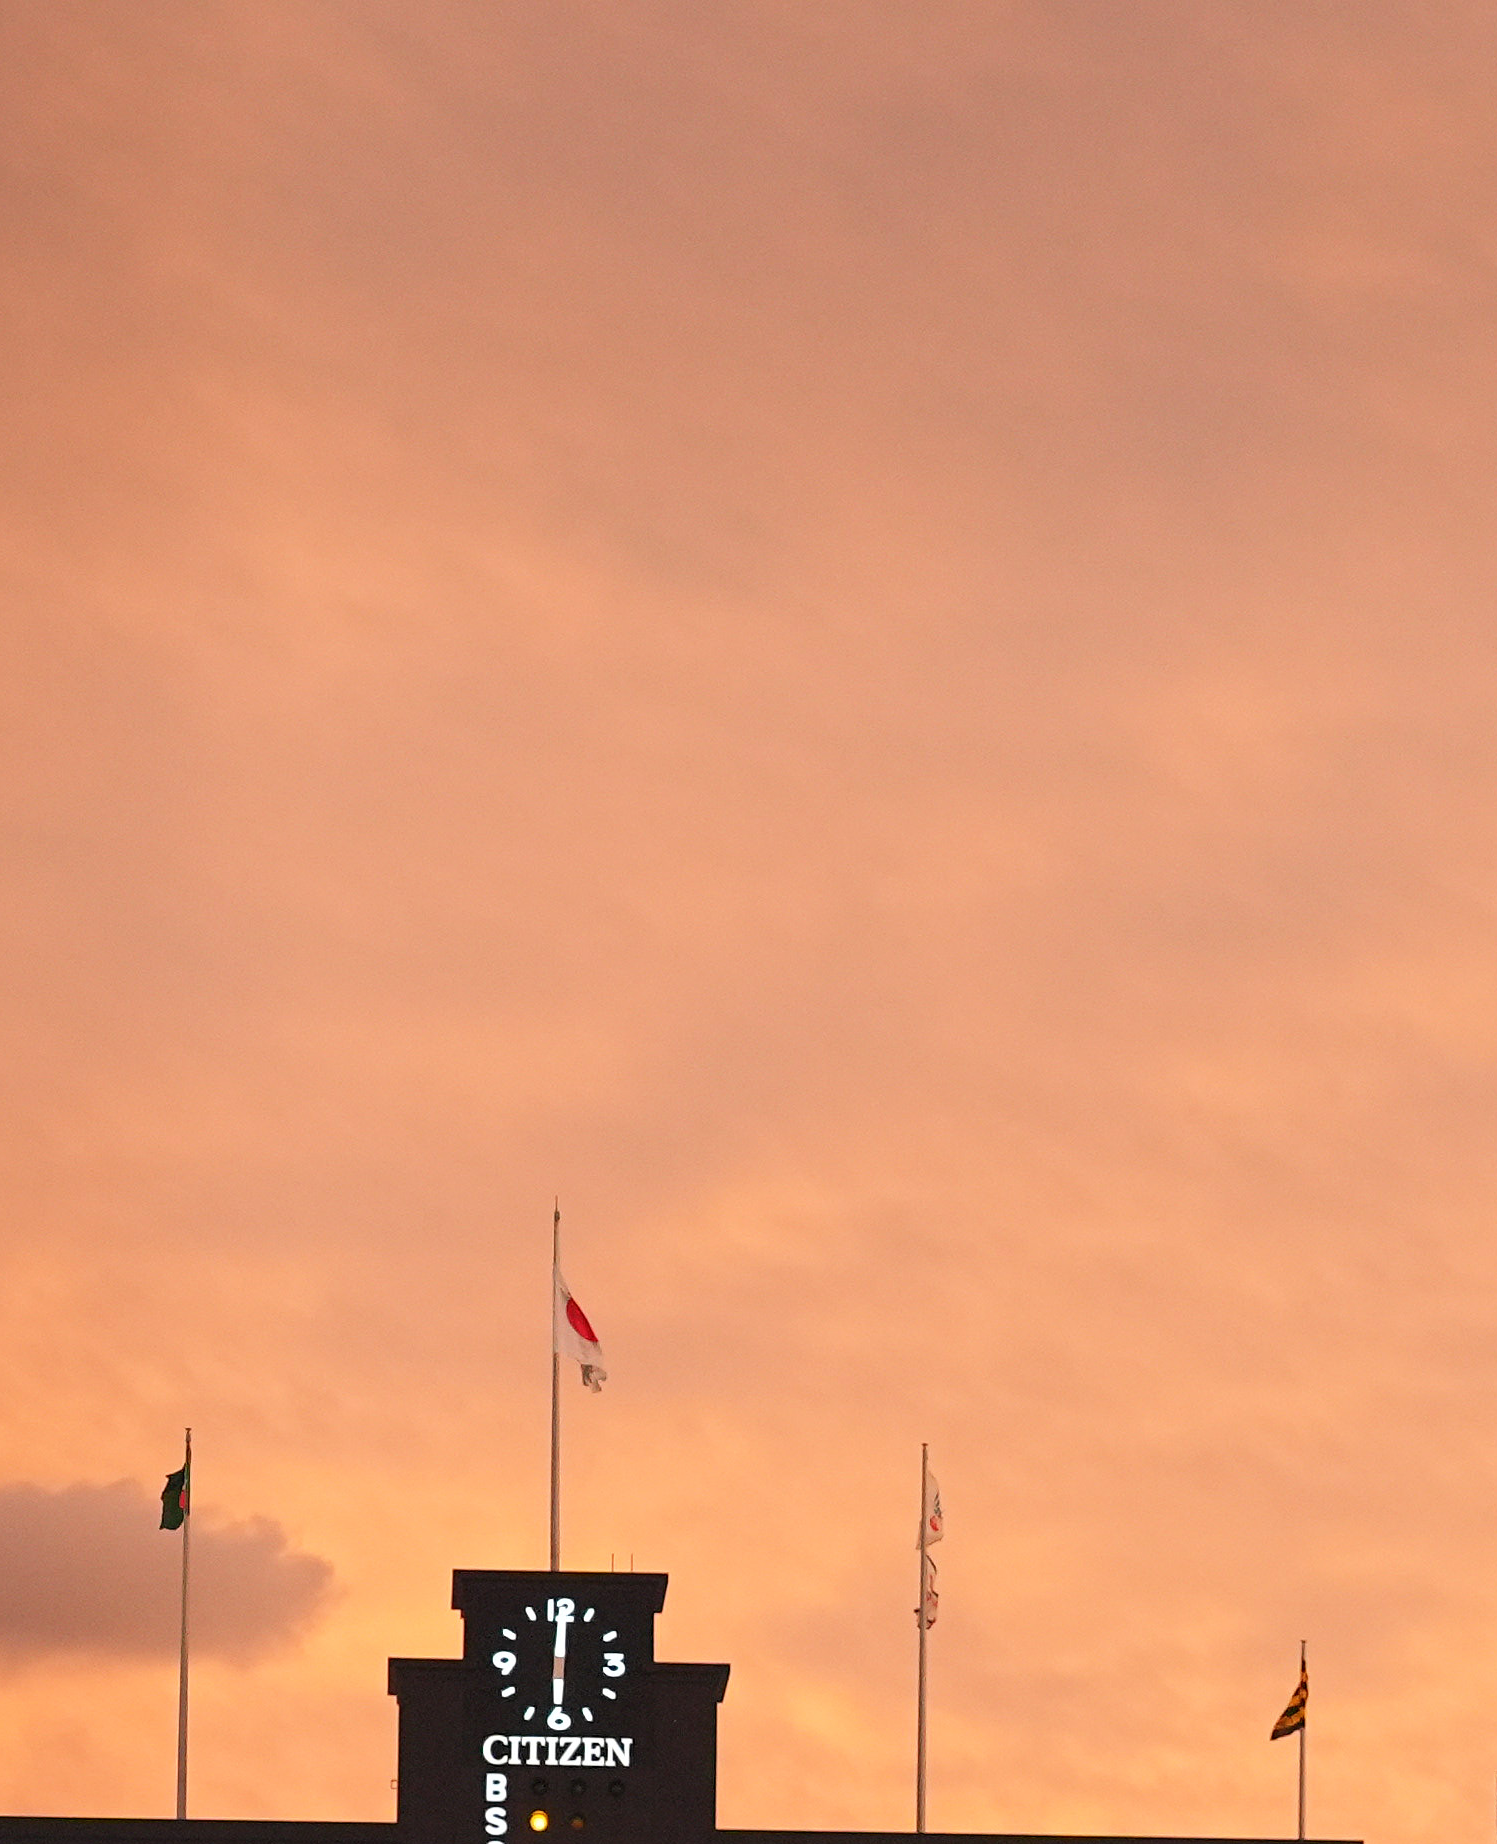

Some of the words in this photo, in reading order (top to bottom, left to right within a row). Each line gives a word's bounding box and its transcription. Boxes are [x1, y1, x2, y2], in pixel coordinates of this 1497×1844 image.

[547, 1598, 575, 1622] 12
[492, 1651, 517, 1677] 9
[602, 1653, 626, 1677] 3
[547, 1706, 572, 1731] 6
[482, 1734, 634, 1767] CITIZEN
[486, 1773, 508, 1802] B
[484, 1806, 508, 1836] S
